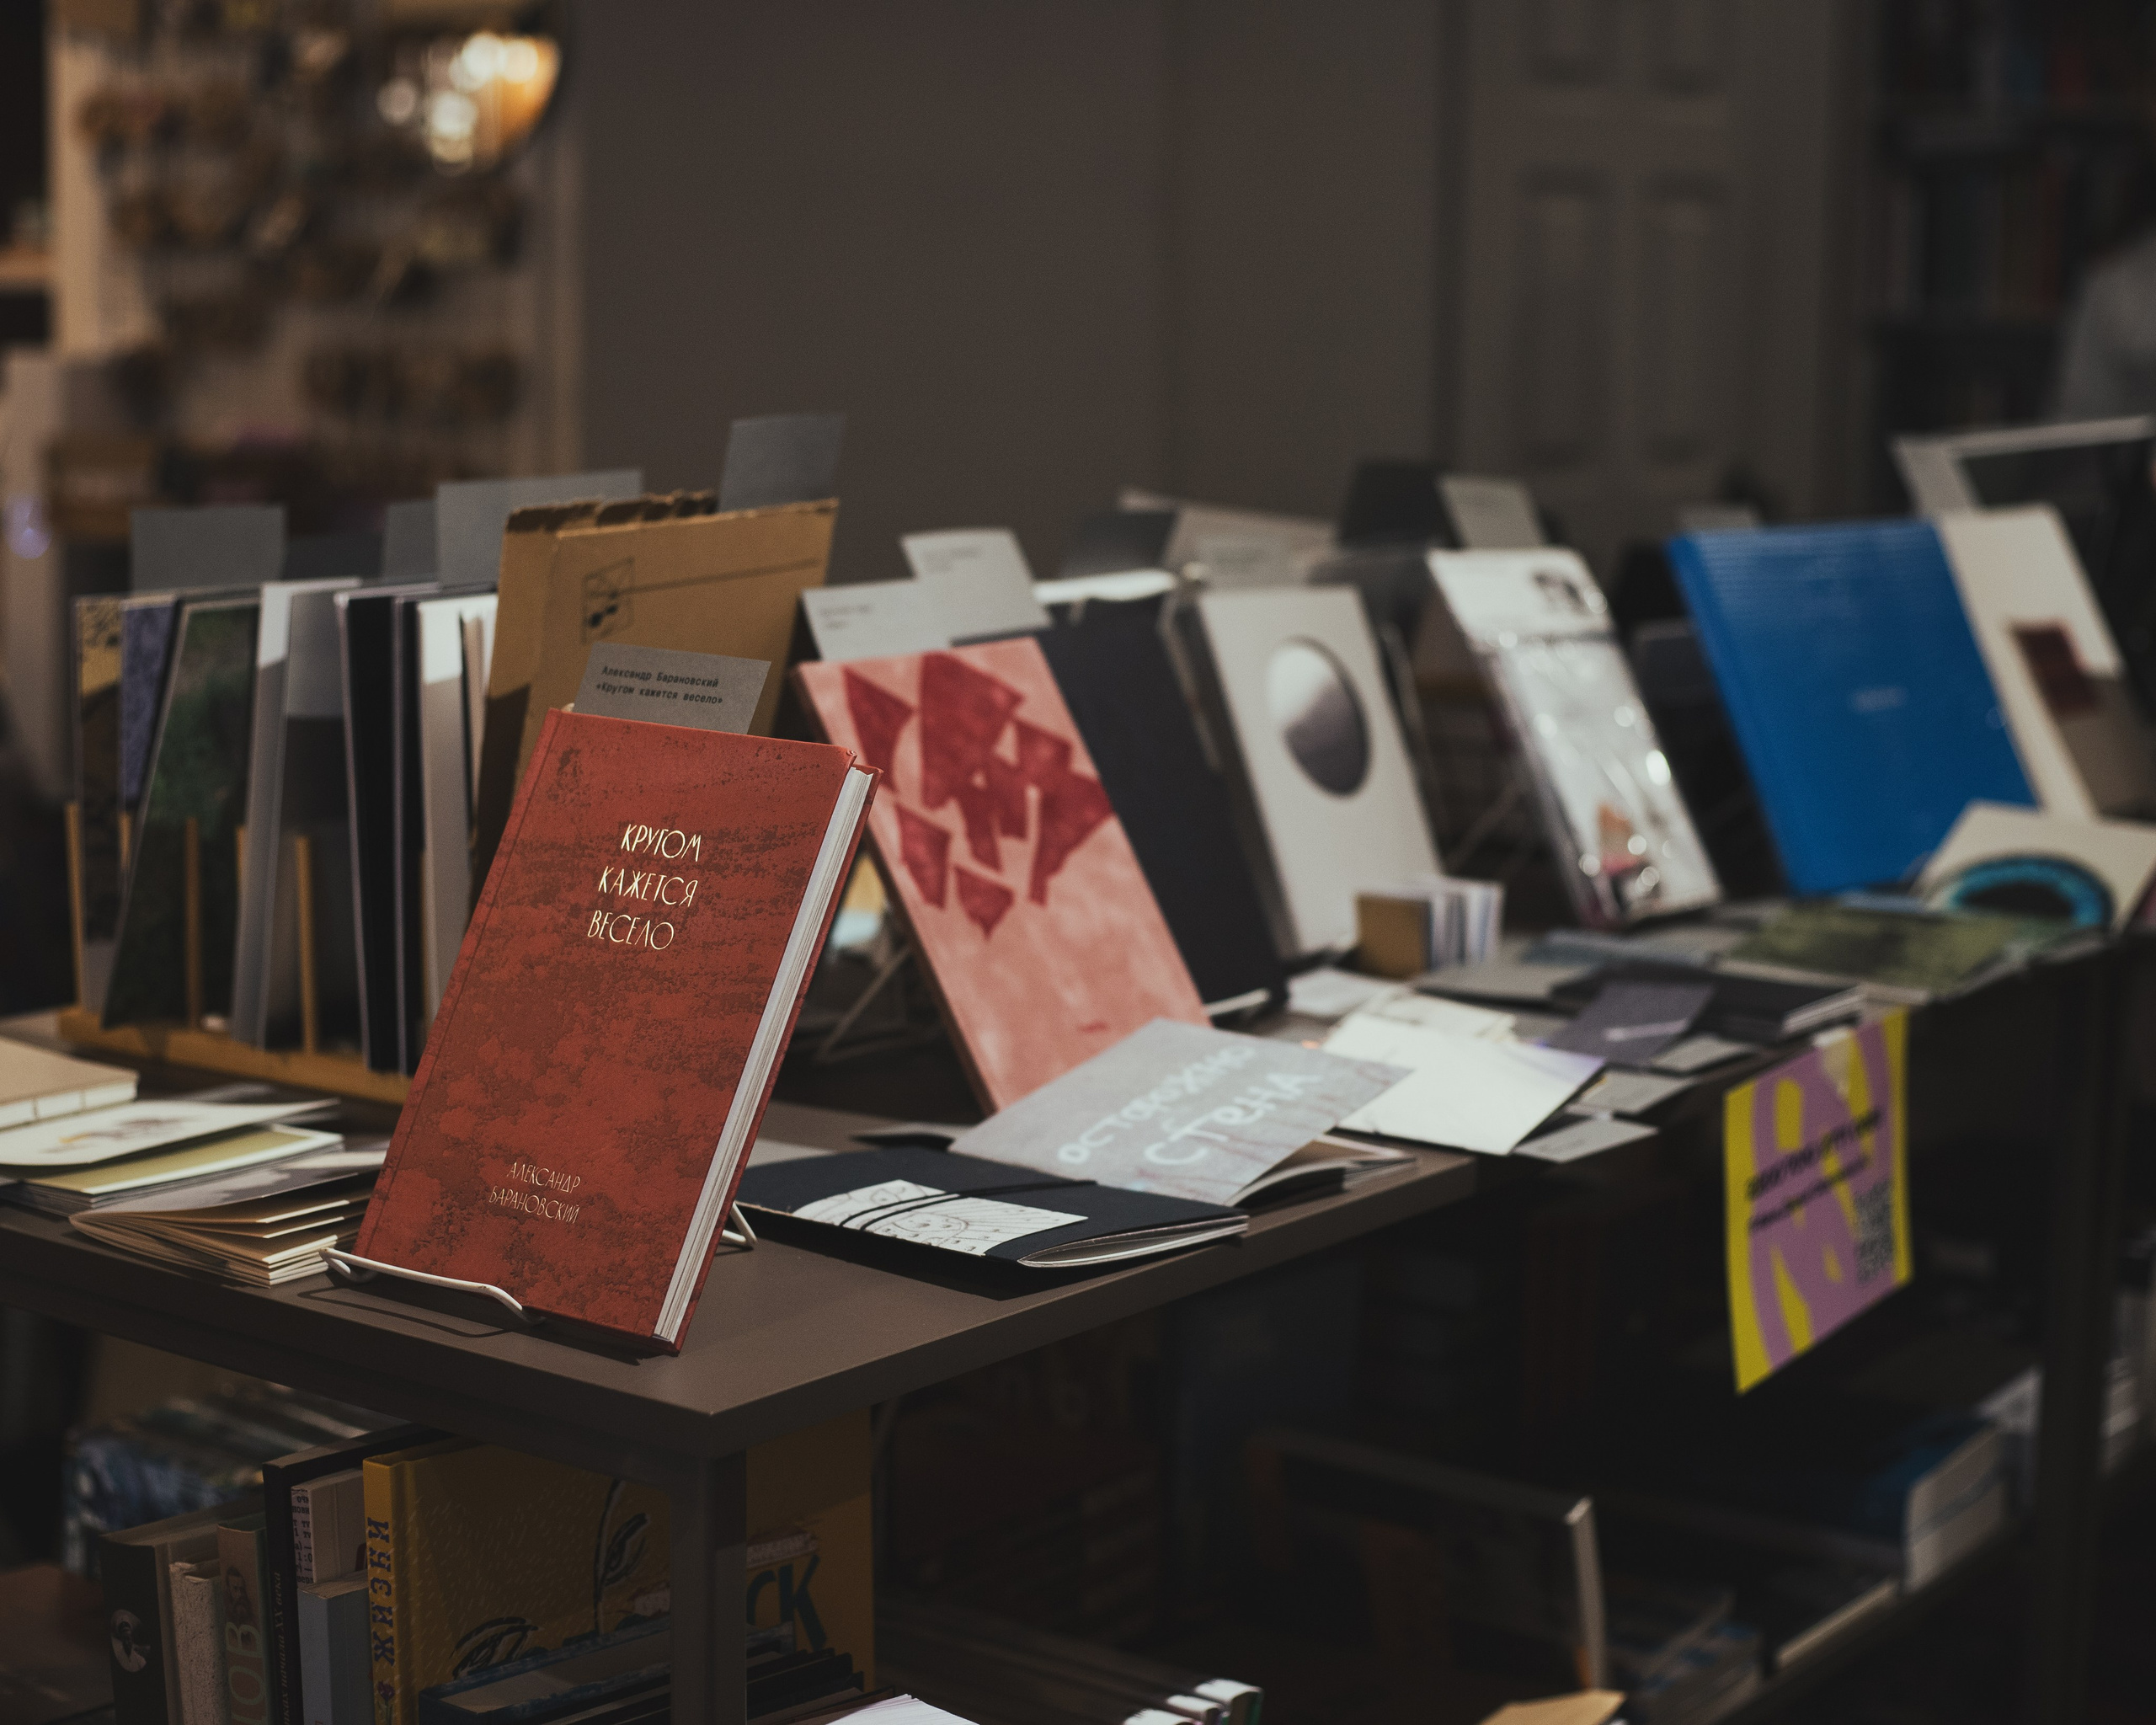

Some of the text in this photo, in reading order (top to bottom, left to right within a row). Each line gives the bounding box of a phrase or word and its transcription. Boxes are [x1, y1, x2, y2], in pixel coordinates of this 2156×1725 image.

[596, 682, 723, 705] «Кругом кажется весело»
[602, 666, 719, 687] Александр Барановский
[621, 823, 702, 862] КРУГОМ
[597, 865, 699, 908] КАЖЕТСЯ
[587, 909, 675, 950] ВЕСЕЛО
[506, 1161, 581, 1194] АЛЕКСАНДР
[488, 1185, 580, 1225] БАРАНОВСКИЙ
[273, 1572, 283, 1605] века
[367, 1516, 396, 1667] ЖИЗНИ
[276, 1634, 289, 1688] начала
